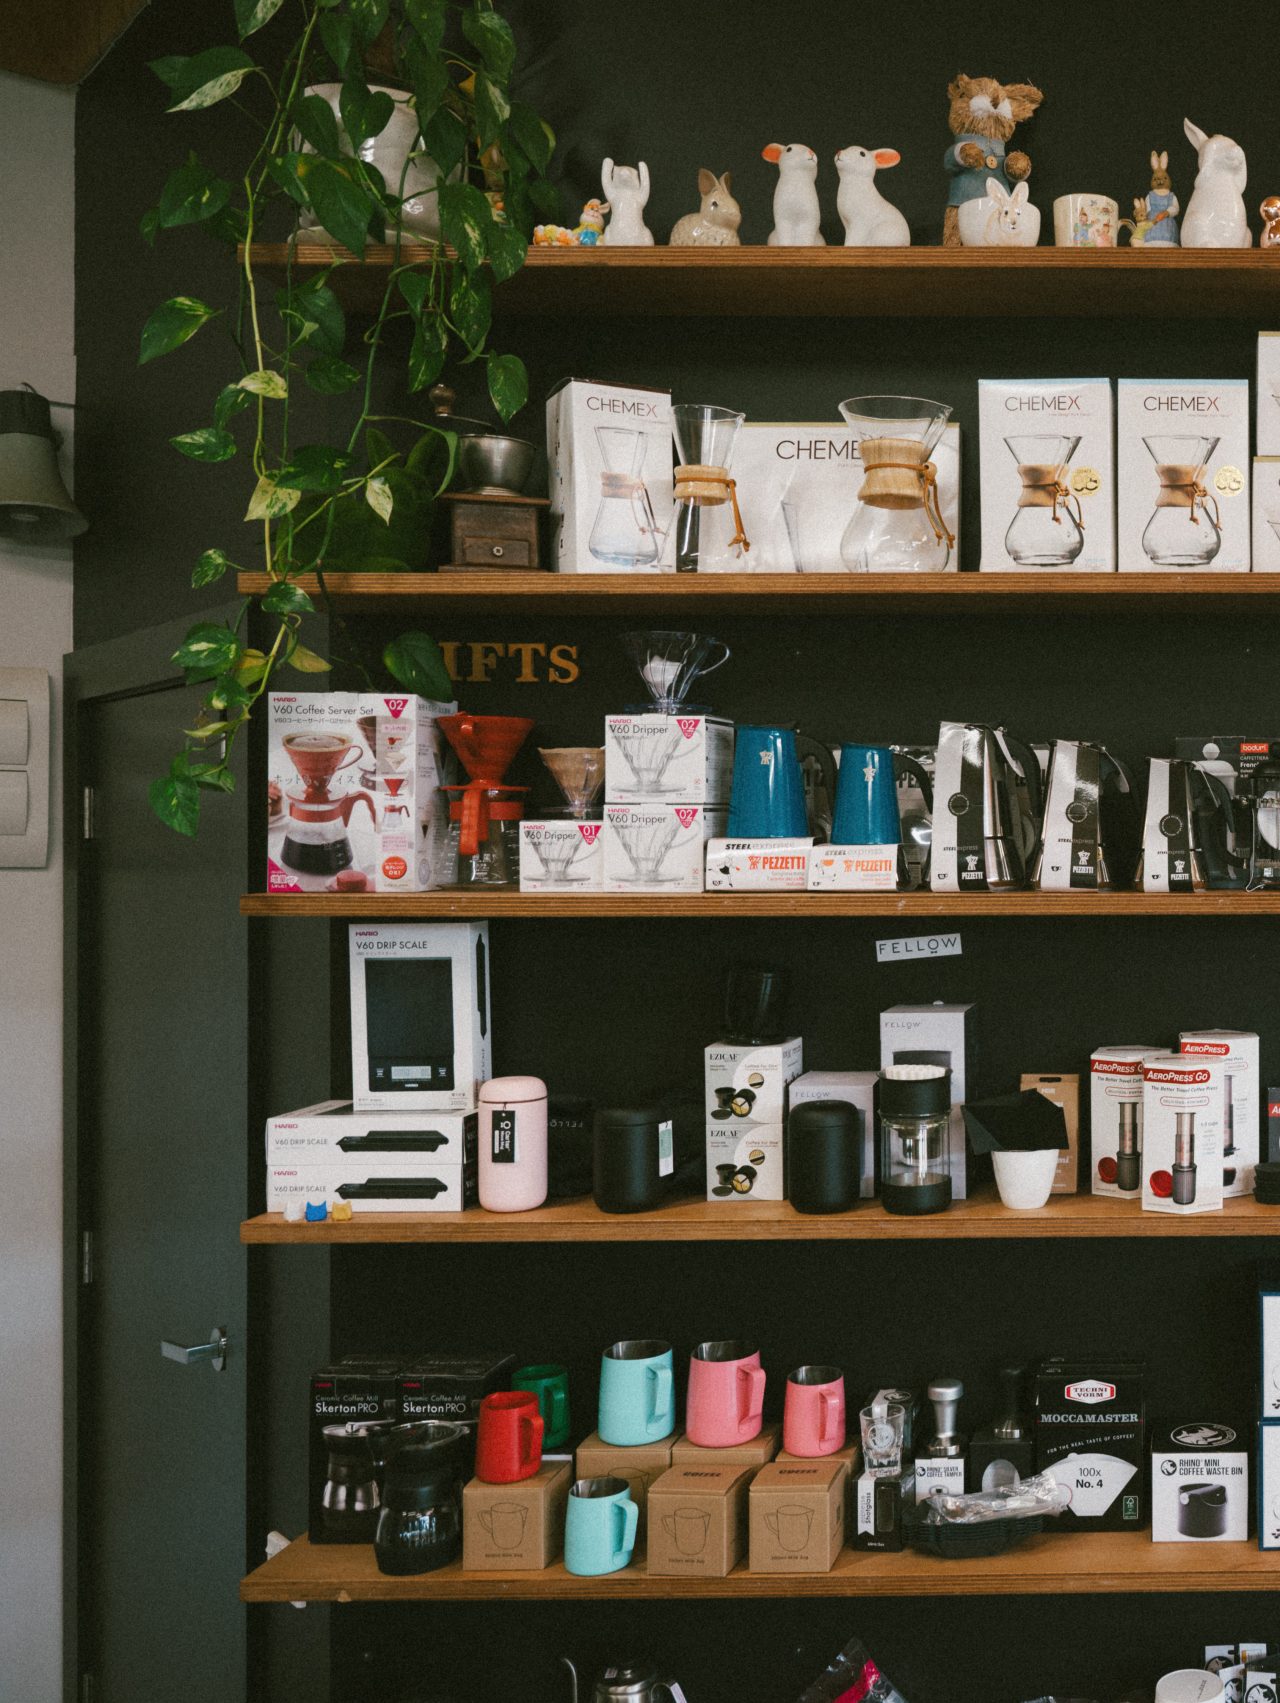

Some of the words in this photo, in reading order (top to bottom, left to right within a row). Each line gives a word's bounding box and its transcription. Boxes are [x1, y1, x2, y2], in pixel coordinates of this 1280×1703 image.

[586, 396, 657, 419] CHEMEX
[1004, 395, 1081, 411] CHEMEX
[1143, 396, 1220, 411] CHEMEX
[776, 439, 862, 460] CHEME
[439, 641, 580, 684] IFTS
[273, 706, 293, 715] V60
[295, 705, 325, 715] Coffee
[328, 706, 357, 716] Server
[360, 707, 374, 715] Set
[388, 700, 404, 711] 02
[680, 719, 695, 730] 02
[609, 724, 630, 734] V60
[632, 724, 669, 737] Dripper
[679, 809, 693, 819] 02
[607, 813, 628, 823] V60
[631, 813, 667, 826] Dripper
[582, 826, 596, 836] 01
[523, 831, 542, 840] V60
[544, 831, 577, 842] Dripper
[762, 856, 806, 870] PEZZETTI
[855, 859, 893, 872] PEZZETTI
[1072, 865, 1094, 874] PEZZETTI
[961, 871, 984, 880] PEZZETTI
[1170, 873, 1189, 881] PEZZETTI
[356, 941, 375, 950] V60
[376, 941, 397, 950] DRIP
[399, 940, 428, 950] SCALE
[878, 937, 957, 955] FELLOW
[885, 1021, 921, 1030] FELLOW
[1195, 1072, 1208, 1081] Go
[795, 1091, 831, 1100] FELLOW
[274, 1138, 288, 1146] V60
[289, 1138, 305, 1146] DRIP
[306, 1137, 328, 1146] SCALE
[274, 1185, 288, 1193] V60
[289, 1185, 305, 1193] DRIP
[305, 1185, 327, 1193] SCALE
[1041, 1413, 1139, 1423] MOCCAMASTER
[1204, 1458, 1220, 1467] MINI
[1079, 1467, 1102, 1477] 100x
[1179, 1467, 1204, 1476] COFFEE
[1205, 1467, 1229, 1476] WASTE
[1231, 1467, 1243, 1476] BIN
[1075, 1479, 1093, 1489] No.
[1095, 1479, 1104, 1489] 4
[865, 1492, 873, 1524] Shotglass
